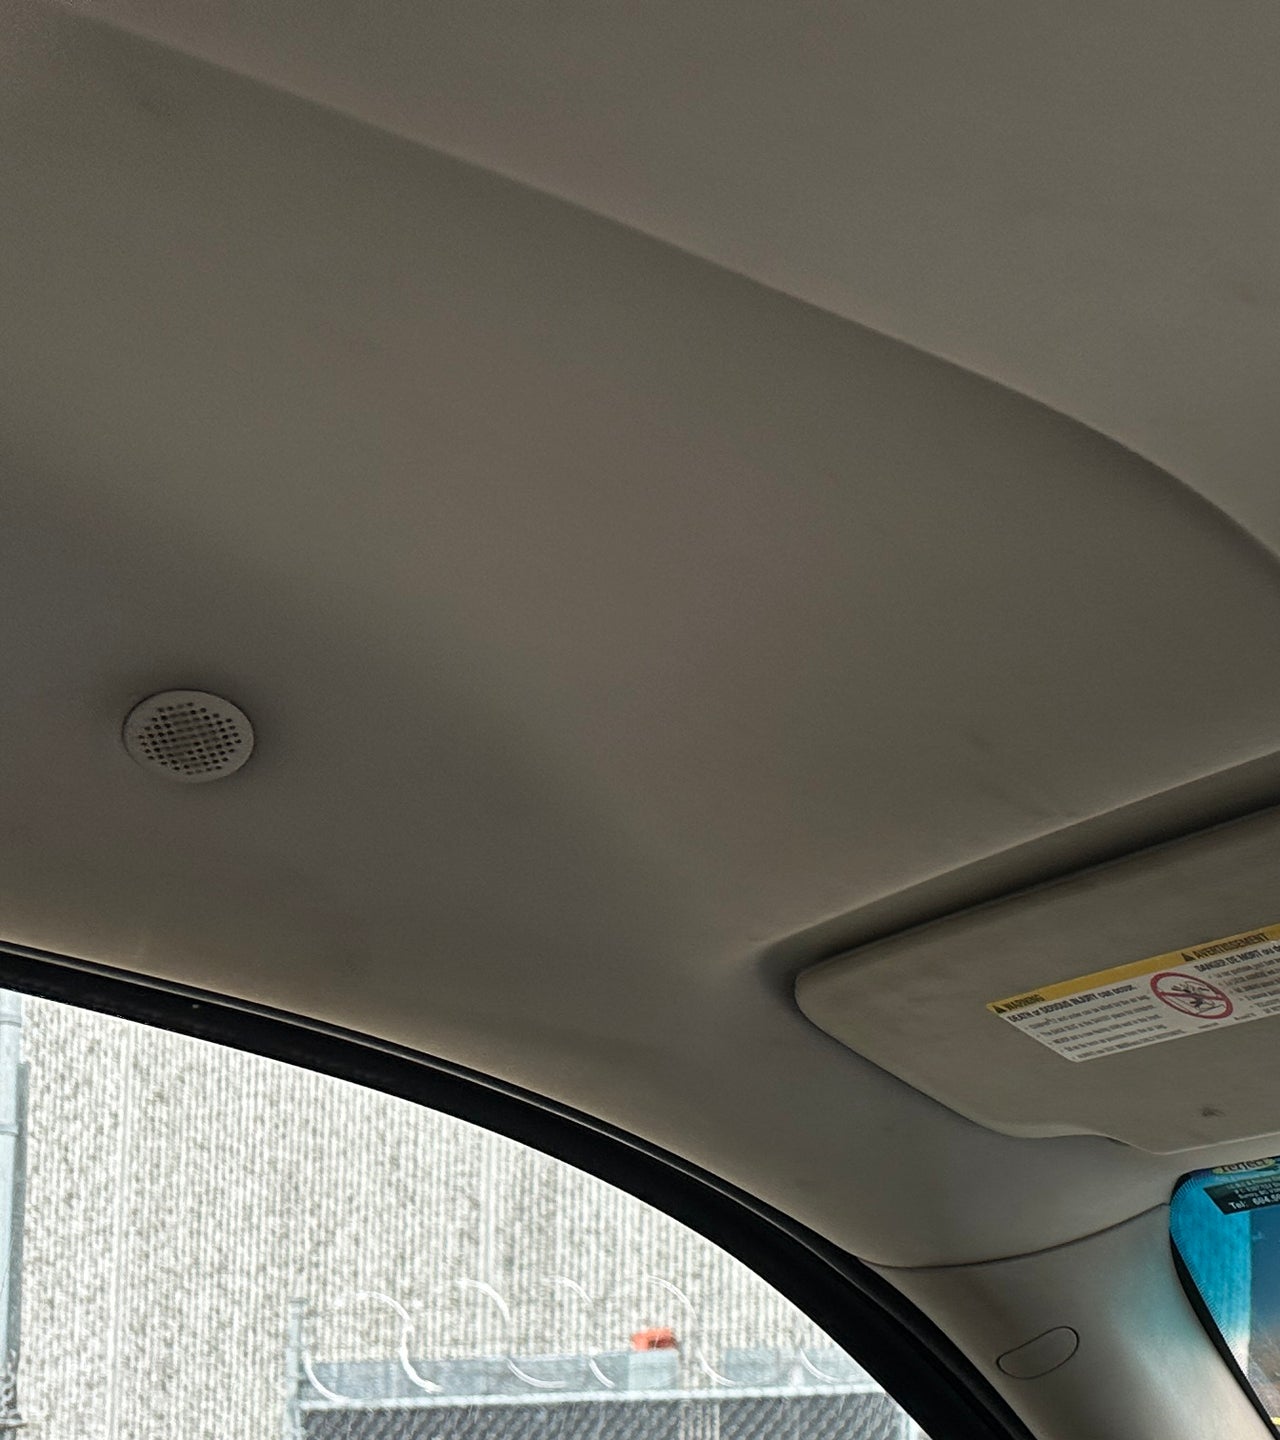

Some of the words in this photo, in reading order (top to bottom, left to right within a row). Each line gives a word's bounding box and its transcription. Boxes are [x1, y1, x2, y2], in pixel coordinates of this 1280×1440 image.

[1193, 933, 1270, 957] AVERTISSEMENT
[1002, 994, 1046, 1009] WARNING
[1004, 1010, 1035, 1023] DEATH
[1028, 1007, 1044, 1017] or
[1037, 999, 1075, 1014] SERIOUS
[1068, 992, 1100, 1006] INJURY
[1094, 988, 1116, 999] can
[1109, 981, 1139, 995] occur.
